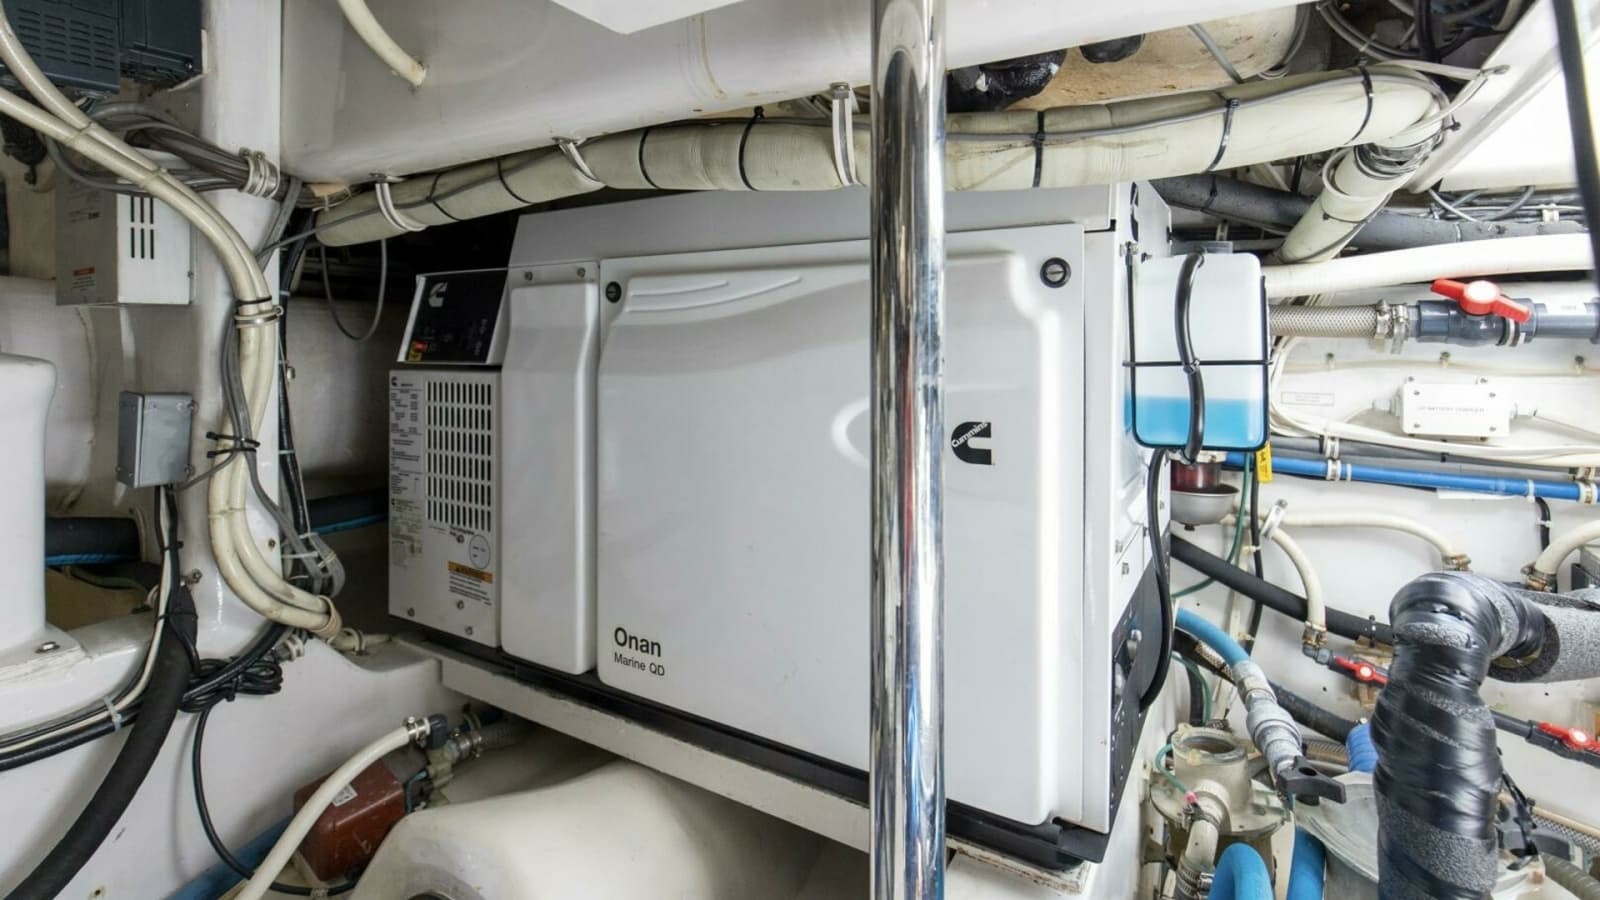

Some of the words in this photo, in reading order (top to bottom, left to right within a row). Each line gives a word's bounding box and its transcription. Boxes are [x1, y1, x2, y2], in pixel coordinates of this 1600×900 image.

[951, 422, 988, 448] Cummins
[614, 627, 661, 658] Onan
[614, 652, 646, 671] Marine
[649, 662, 665, 676] QD
